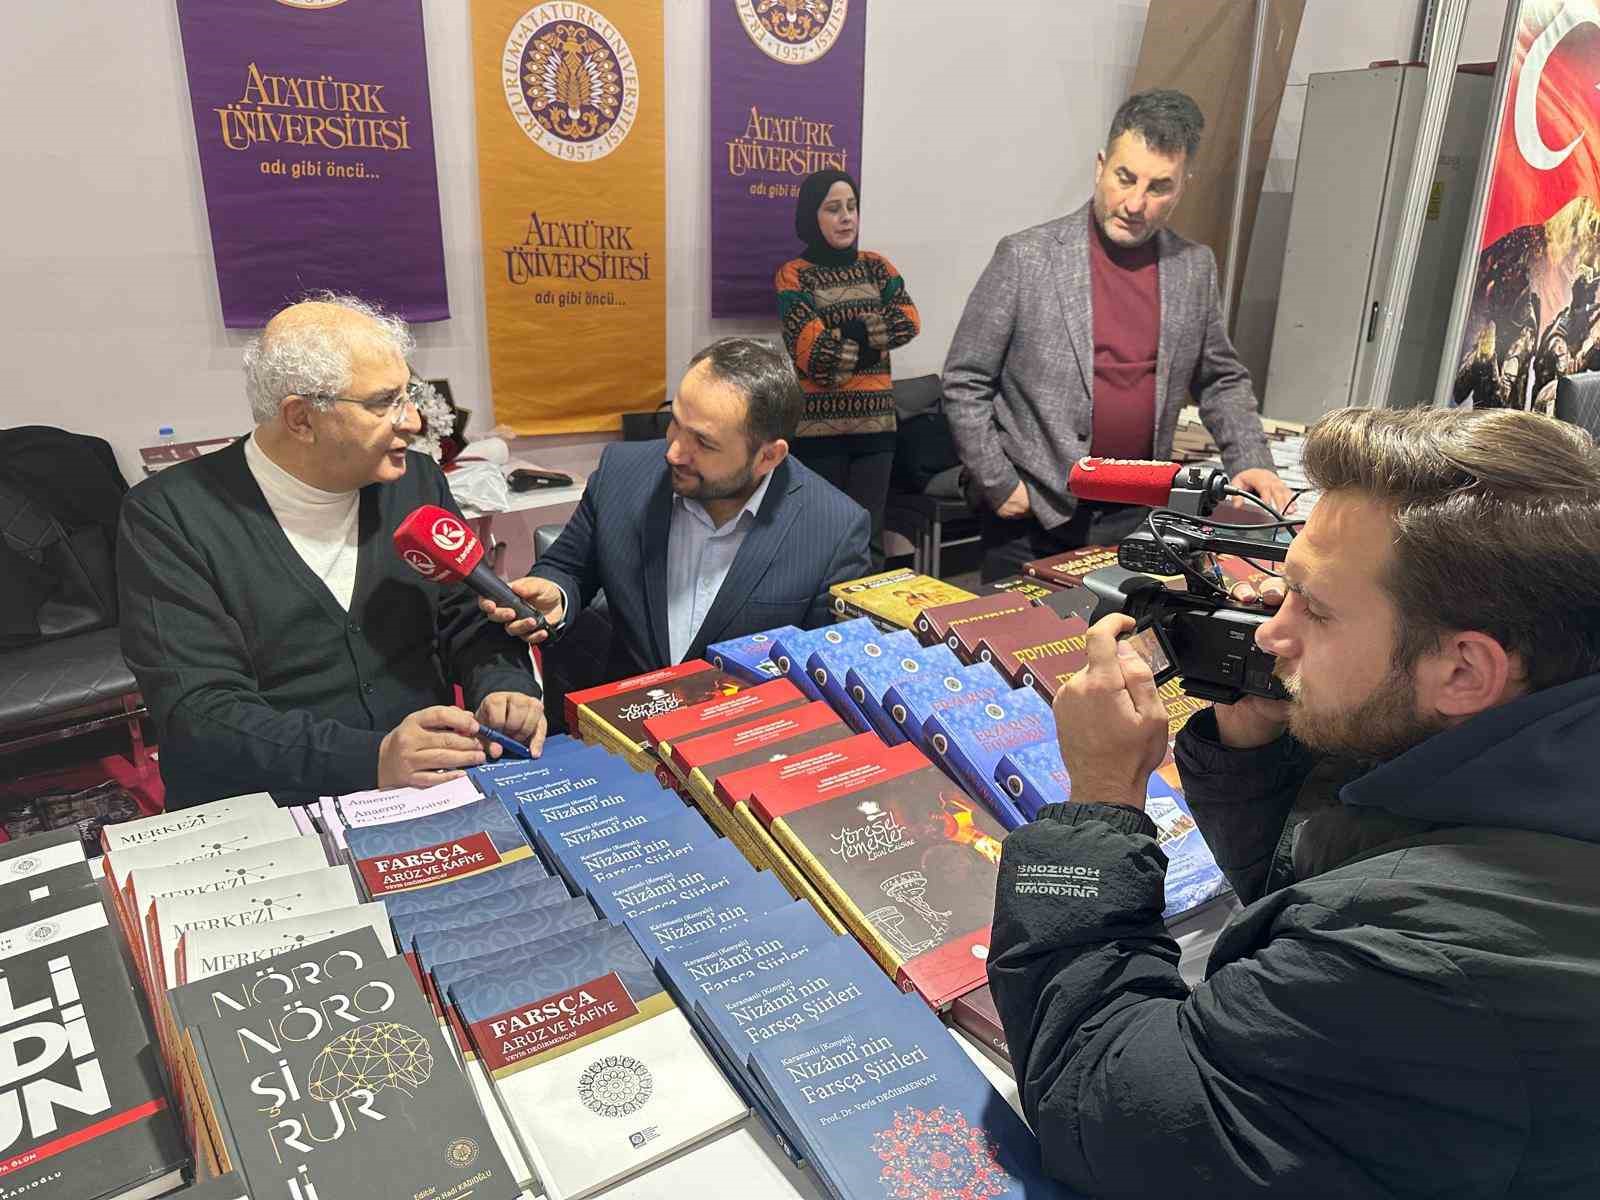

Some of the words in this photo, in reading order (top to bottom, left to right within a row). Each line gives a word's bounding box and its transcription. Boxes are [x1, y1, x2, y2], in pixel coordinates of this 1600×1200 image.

[774, 44, 806, 60] 1957
[239, 61, 388, 114] ATATÜRK
[213, 104, 412, 151] ÜNİVERSİTESİ
[743, 104, 835, 147] ATATÜRK
[260, 159, 287, 175] adı
[291, 159, 322, 179] gibi
[556, 142, 596, 161] 1957
[769, 182, 788, 199] gibi
[523, 211, 633, 250] ATATÜRK
[504, 246, 651, 285] ÜNİVERSİTESİ
[535, 291, 554, 304] adı
[559, 290, 581, 308] gibi
[374, 843, 468, 873] FARSÇA
[424, 865, 440, 877] VE
[442, 852, 485, 872] KAFİYE
[1017, 864, 1101, 877] HORIZONS
[1015, 885, 1099, 898] UNKNOWN
[212, 950, 364, 1018] NÖRO
[237, 981, 395, 1064] NÖRO
[489, 990, 598, 1039] FARSÇA
[550, 1021, 569, 1035] VE
[570, 1001, 619, 1029] KAFİYE
[744, 1012, 805, 1045] Farsça
[802, 982, 863, 1022] Şiirleri
[800, 1073, 865, 1105] Farsça
[864, 1045, 928, 1083] Şiirleri
[268, 1088, 386, 1165] RUR
[819, 1113, 841, 1127] Prof.
